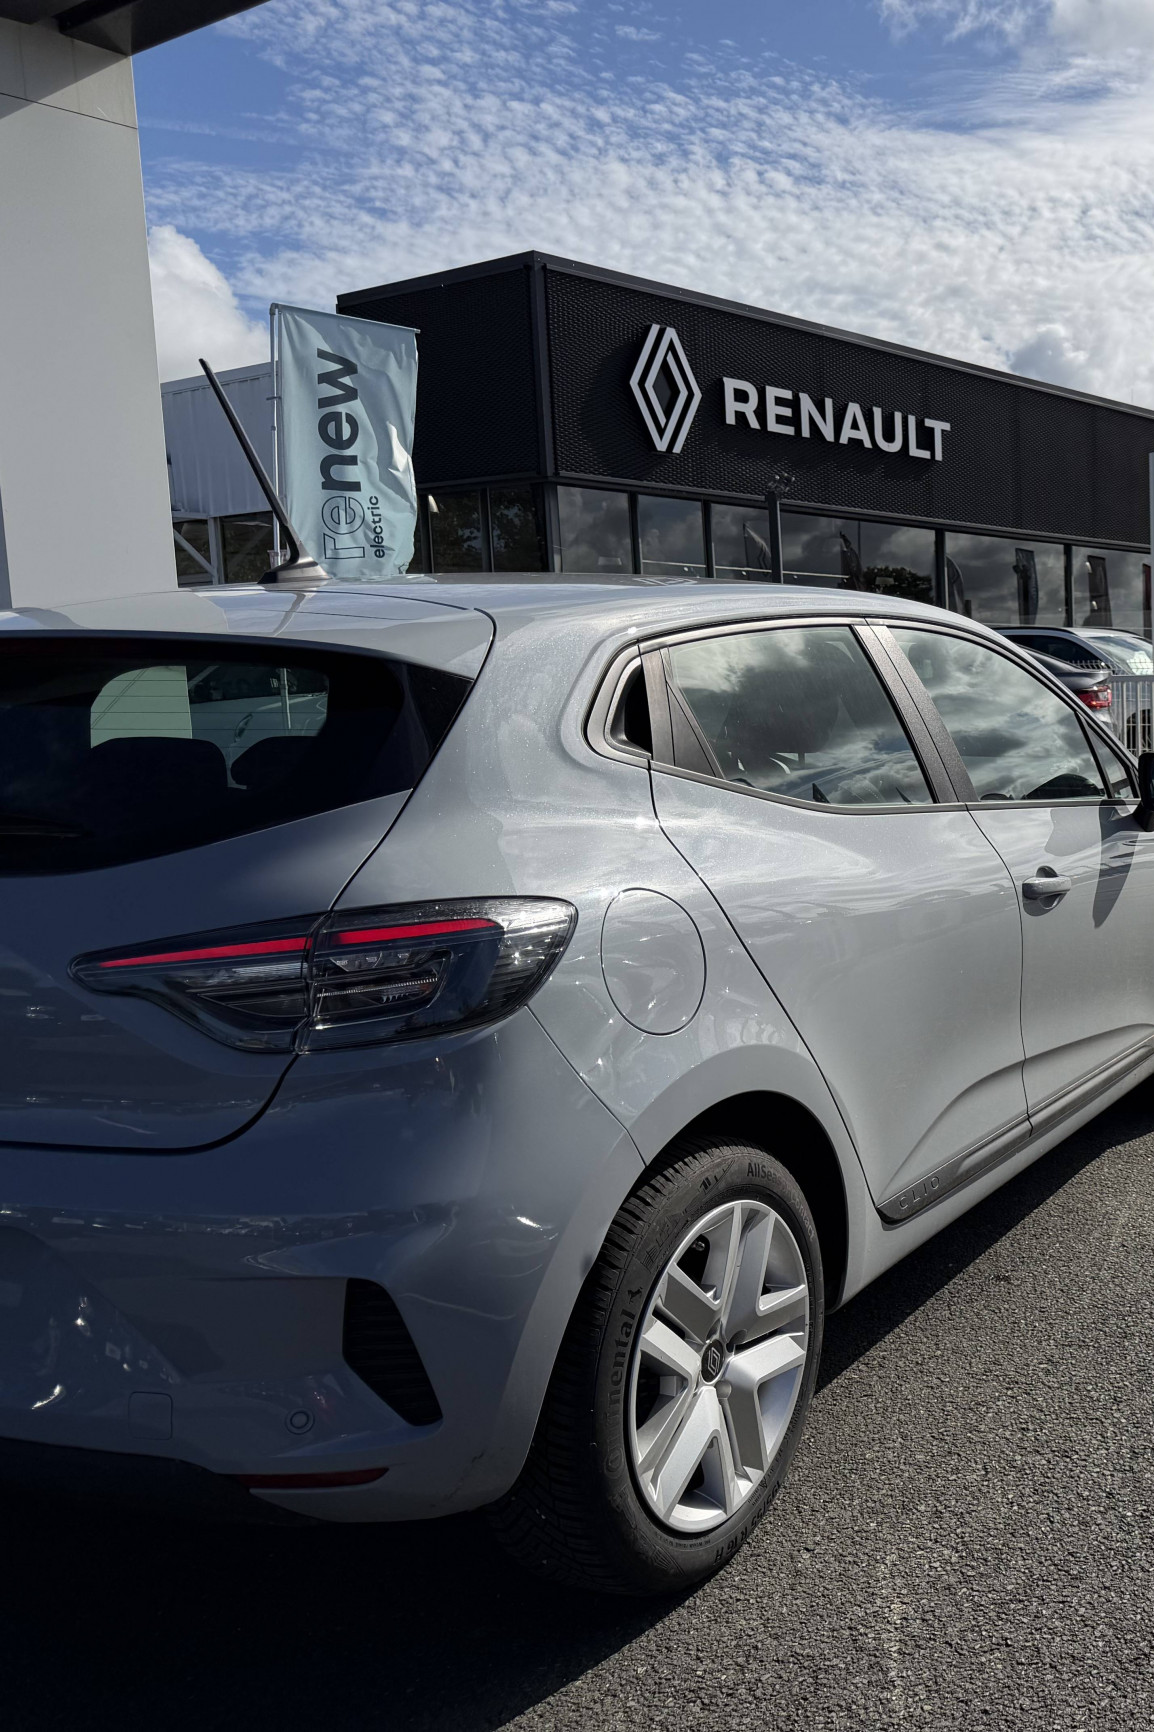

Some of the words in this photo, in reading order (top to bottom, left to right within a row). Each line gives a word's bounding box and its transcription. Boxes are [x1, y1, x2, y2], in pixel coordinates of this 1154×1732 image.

[316, 347, 366, 560] renew
[722, 375, 952, 462] RENAULT
[367, 494, 386, 559] electric
[899, 1175, 941, 1210] CLIO
